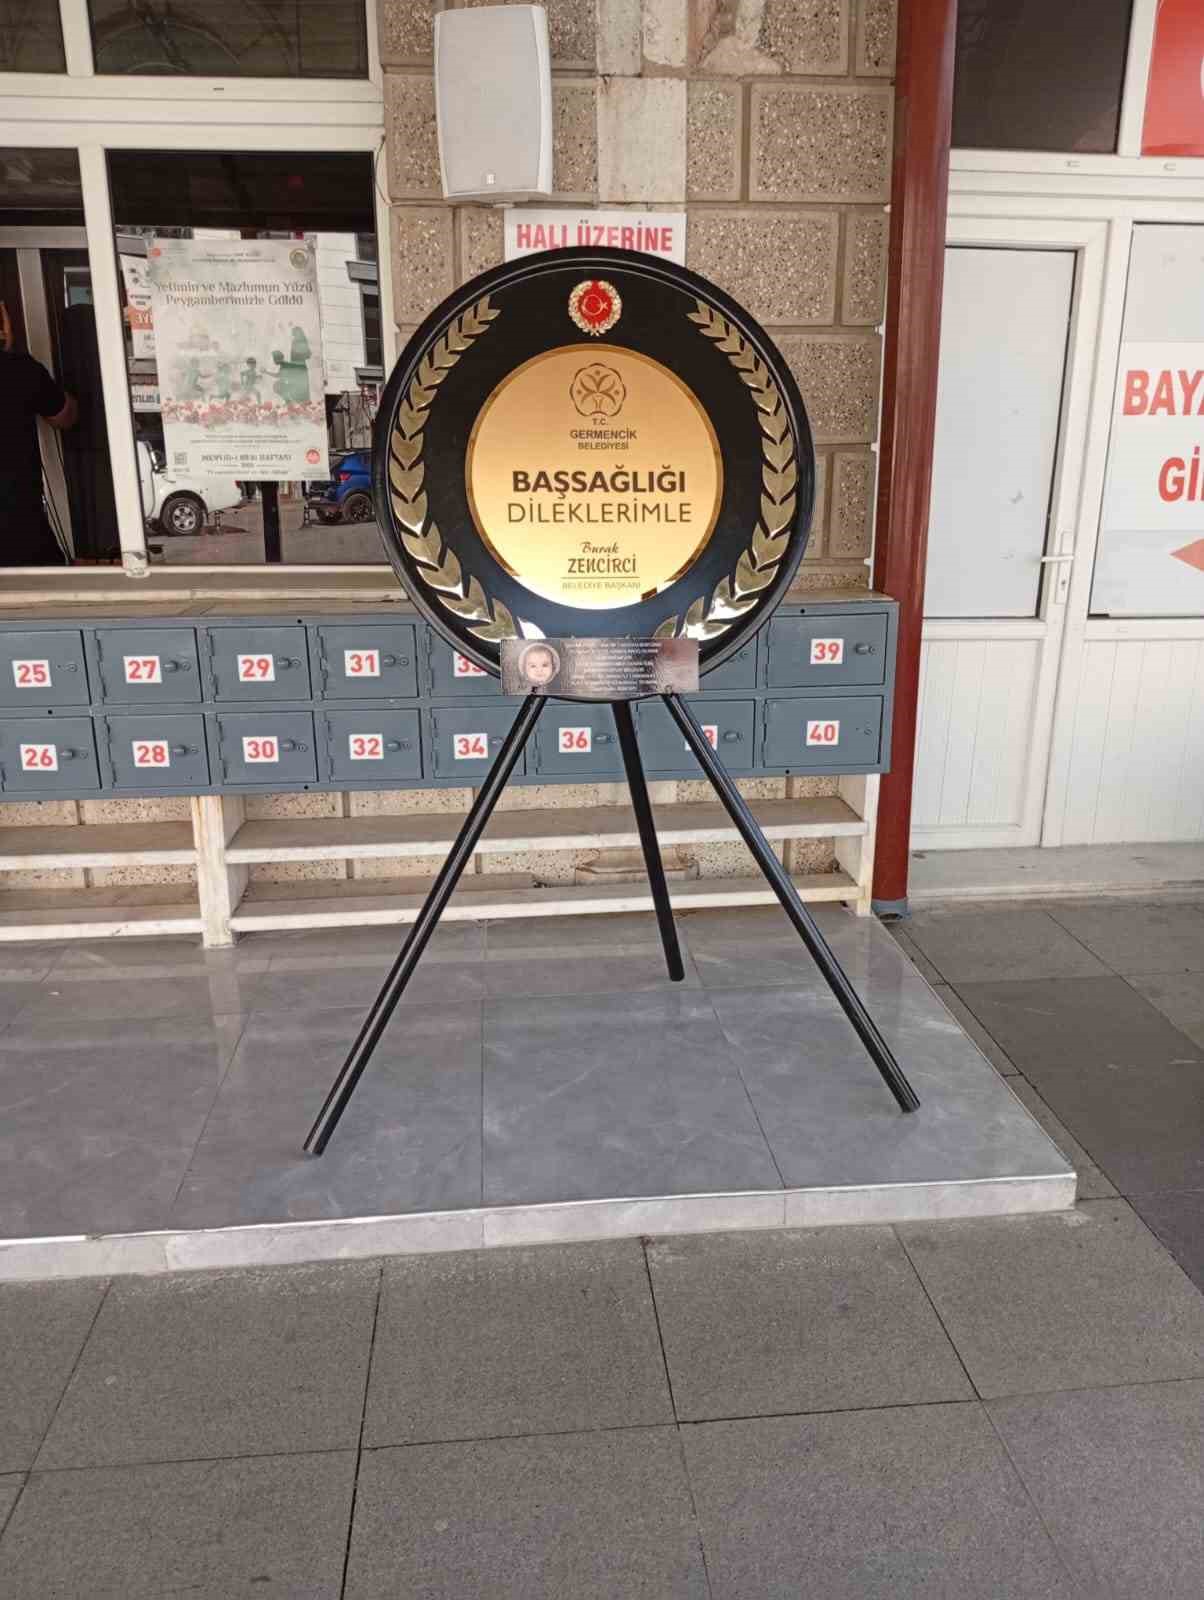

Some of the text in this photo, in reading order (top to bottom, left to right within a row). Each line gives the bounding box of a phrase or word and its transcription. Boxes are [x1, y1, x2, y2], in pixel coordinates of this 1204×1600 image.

[516, 220, 673, 252] HALI ÜZERİNE
[1122, 369, 1204, 417] BAY
[569, 428, 637, 440] GERMENCİK
[577, 442, 629, 450] BELEDİYESİ
[512, 464, 686, 498] BAŞSAĞLIĞI
[1158, 446, 1204, 503] Gİ
[507, 498, 692, 523] DİLEKLERİMLE
[581, 541, 619, 554] Burak
[567, 554, 637, 574] ZENCİRCİ
[814, 641, 841, 660] 39
[17, 663, 48, 684] 25
[129, 660, 156, 681] 27
[243, 658, 271, 678] 29
[351, 655, 375, 673] 31
[563, 730, 589, 749] 36
[809, 724, 837, 742] 40
[25, 747, 54, 768] 26
[137, 744, 166, 765] 28
[248, 740, 275, 759] 30
[353, 738, 380, 757] 32
[458, 738, 486, 757] 34
